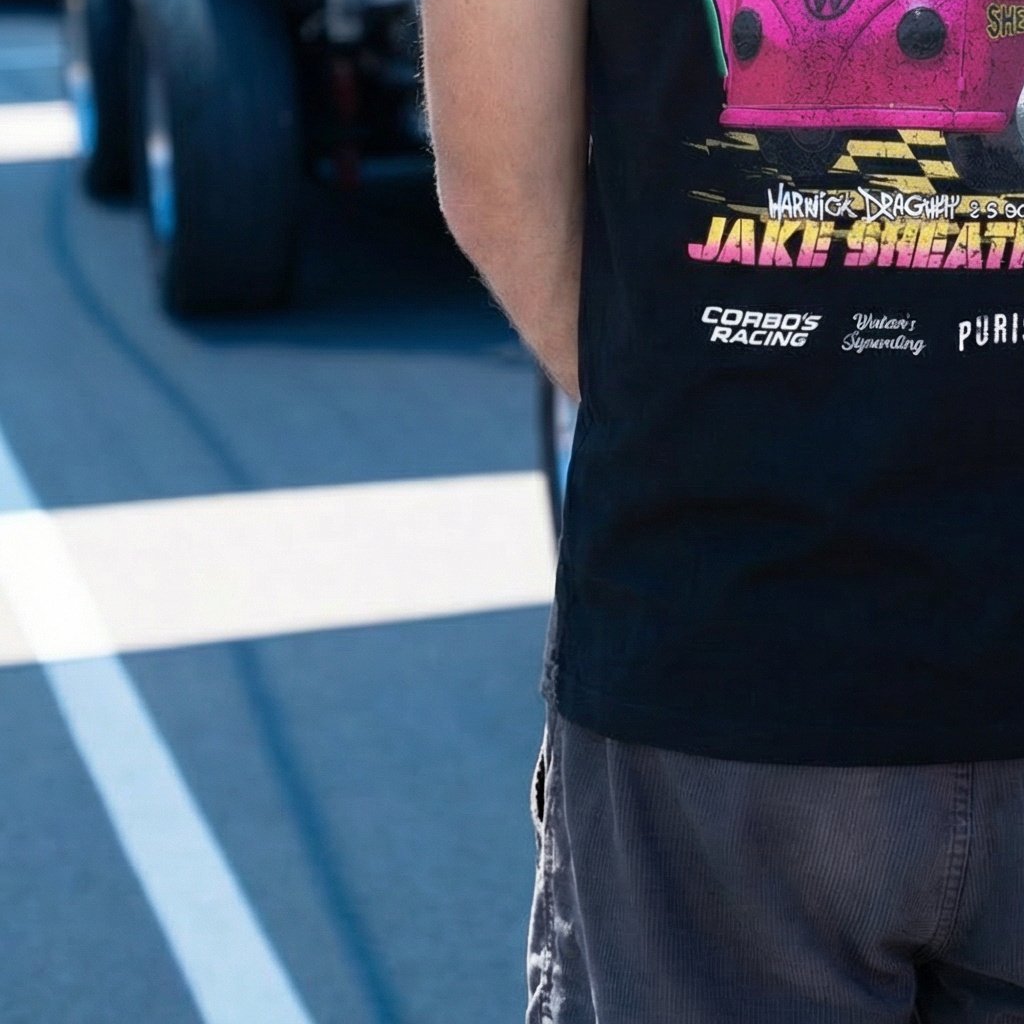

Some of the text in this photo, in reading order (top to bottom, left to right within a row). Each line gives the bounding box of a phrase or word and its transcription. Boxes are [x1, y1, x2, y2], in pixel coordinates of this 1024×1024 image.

[688, 216, 836, 268] JAKE
[701, 305, 823, 332] CORBO'S
[709, 325, 809, 348] RACING
